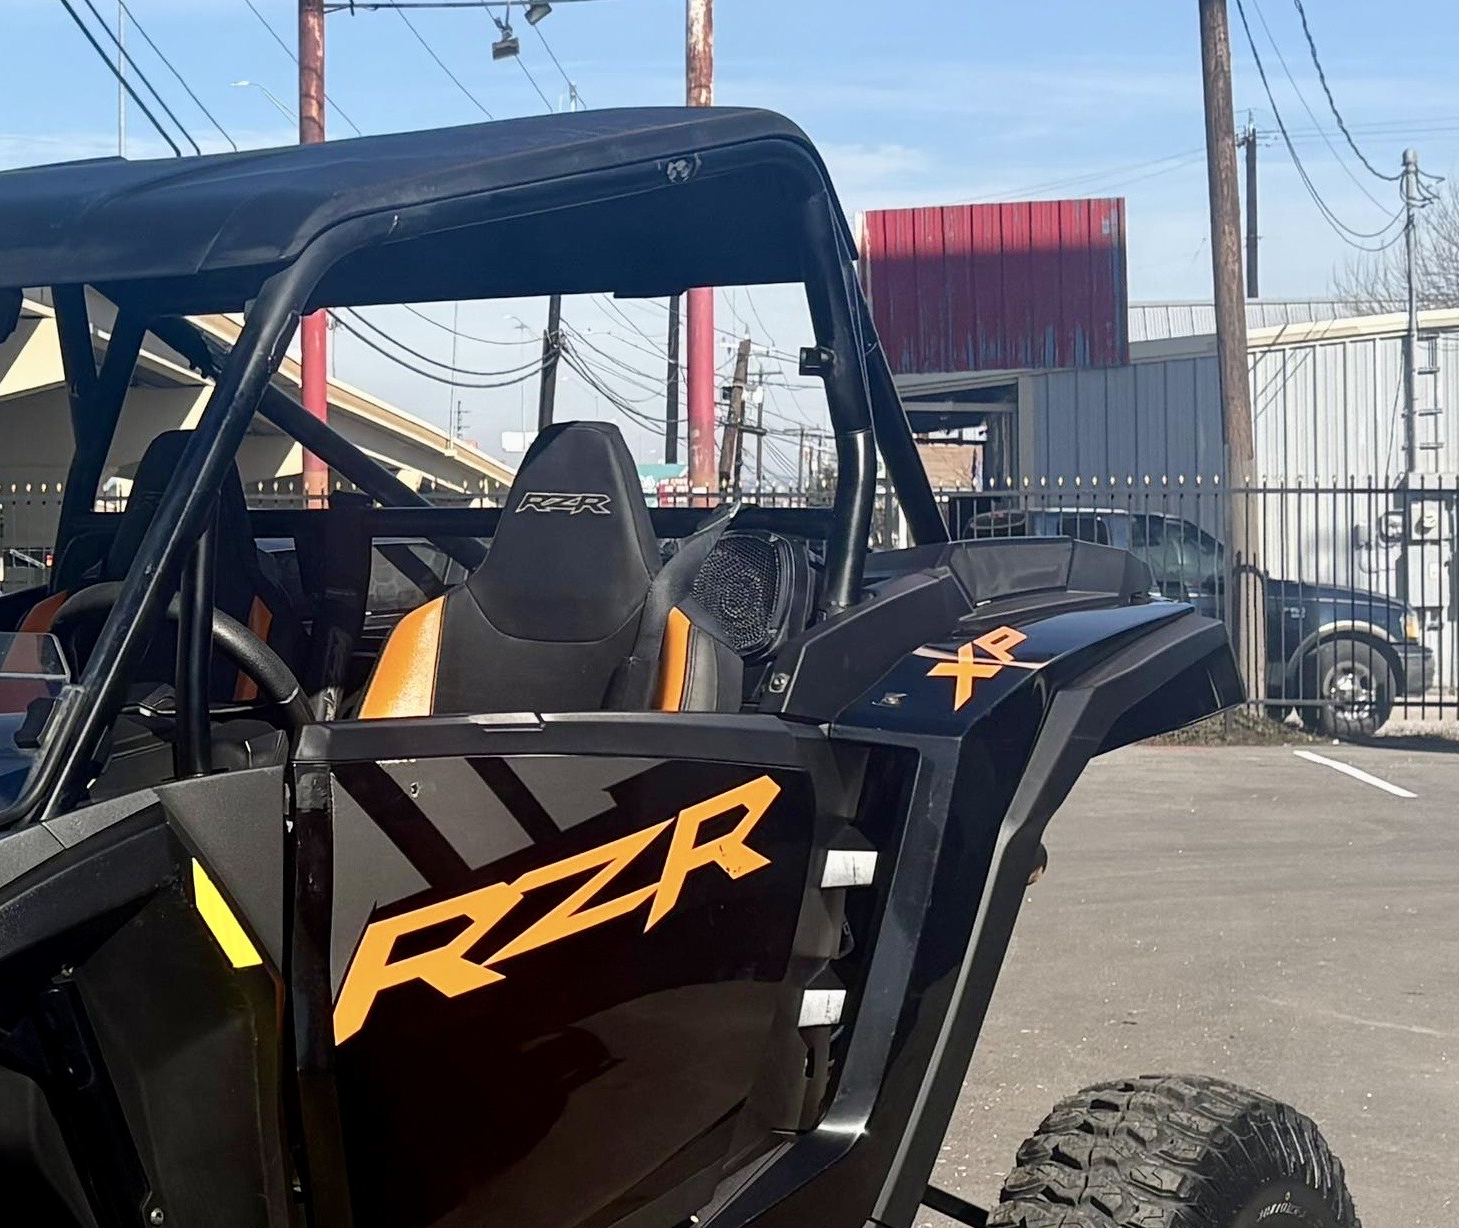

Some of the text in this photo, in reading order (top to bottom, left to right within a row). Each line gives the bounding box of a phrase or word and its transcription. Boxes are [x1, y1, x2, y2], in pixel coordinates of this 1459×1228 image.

[515, 492, 611, 515] RZR
[926, 625, 1028, 712] XP
[332, 774, 781, 1046] RZR
